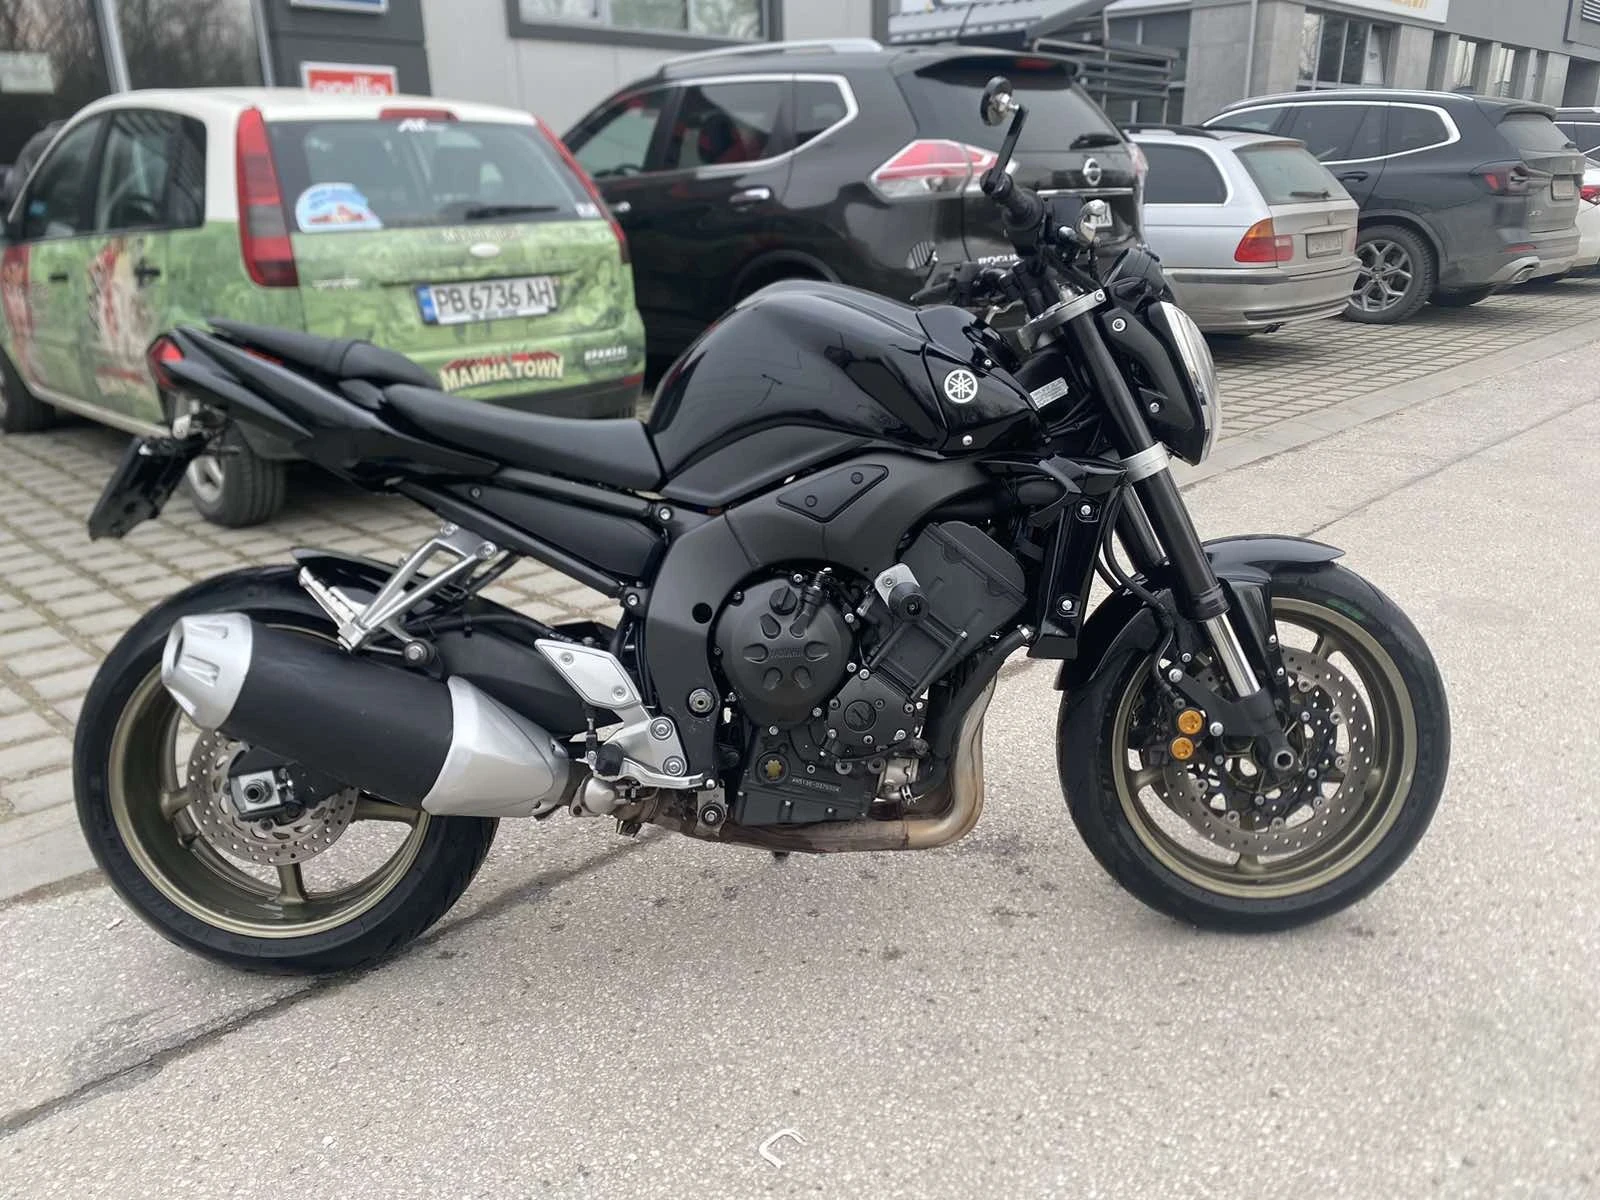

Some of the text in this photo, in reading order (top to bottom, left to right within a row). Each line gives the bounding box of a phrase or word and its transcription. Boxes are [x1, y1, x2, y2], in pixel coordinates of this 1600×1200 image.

[468, 283, 522, 311] 6736
[526, 280, 551, 307] AH
[511, 355, 565, 380] TOWN
